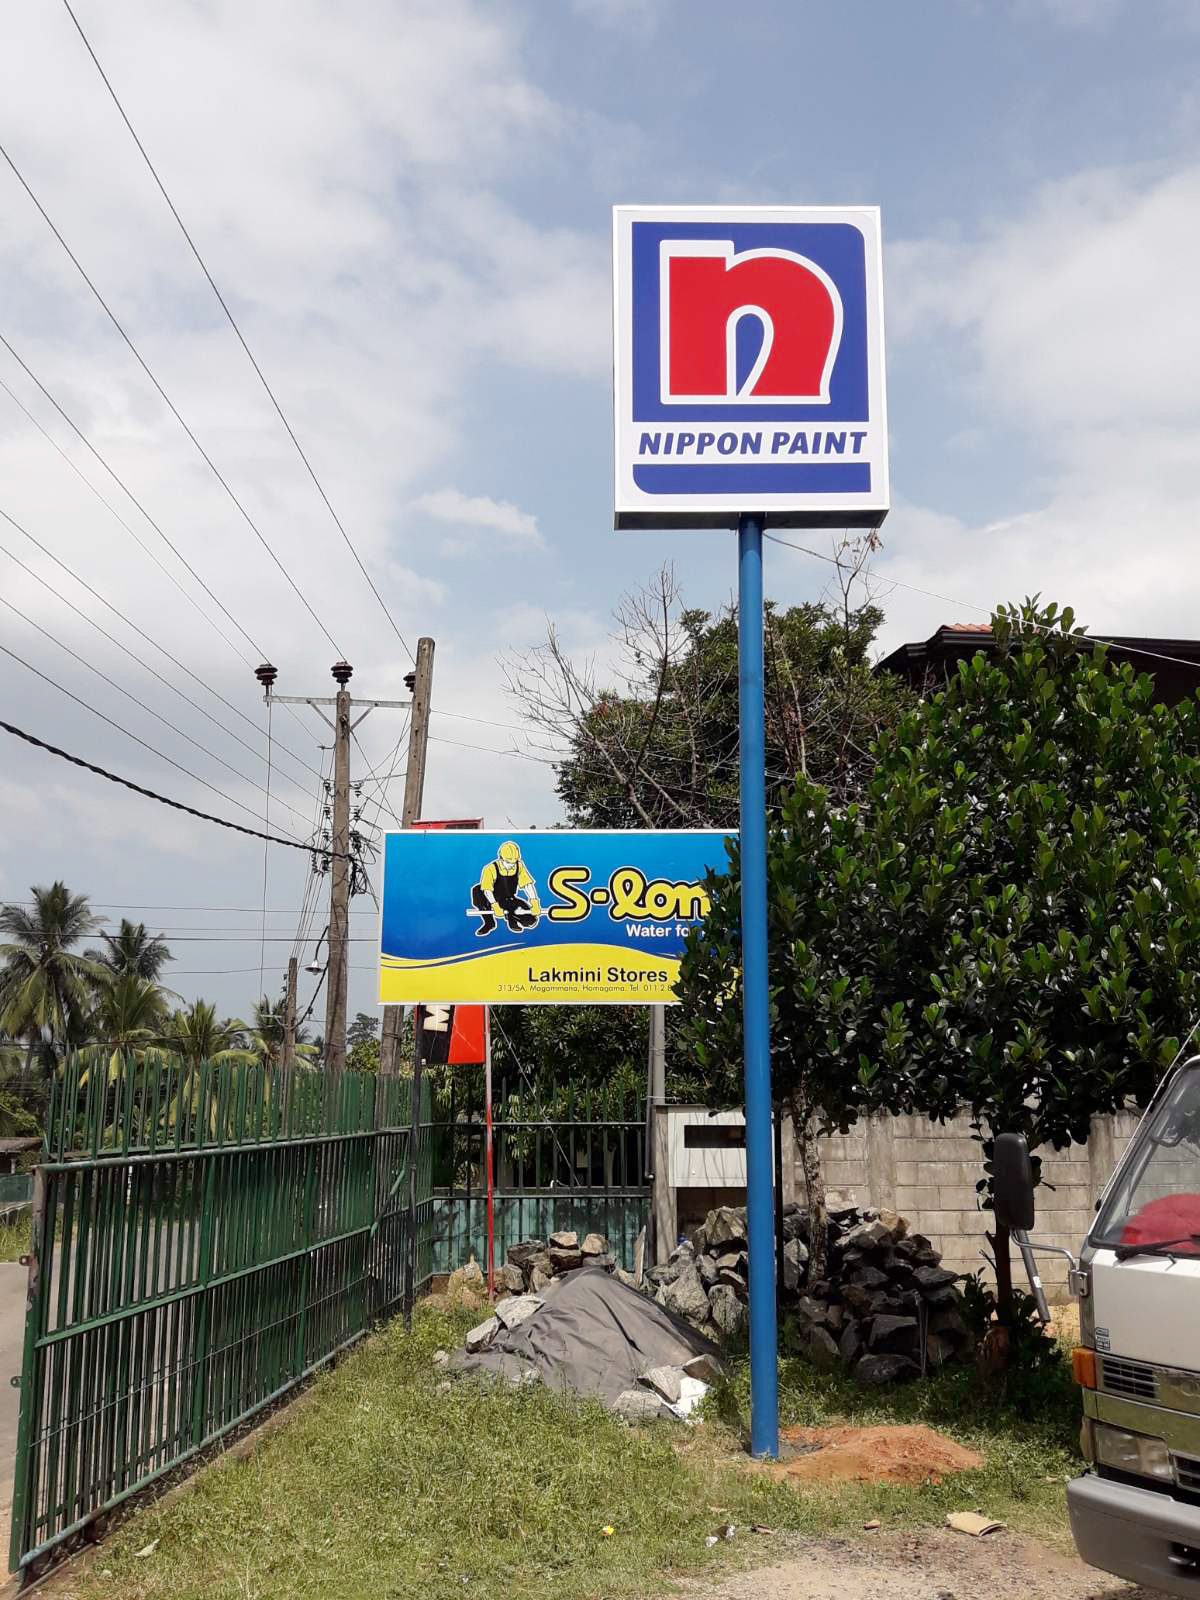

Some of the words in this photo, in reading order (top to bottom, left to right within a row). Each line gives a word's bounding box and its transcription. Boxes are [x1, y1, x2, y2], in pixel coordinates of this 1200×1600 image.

[638, 432, 762, 455] NIPPON
[770, 431, 867, 455] PAINT
[626, 924, 671, 937] Water
[528, 967, 601, 982] Lakmini
[607, 967, 668, 982] Stores
